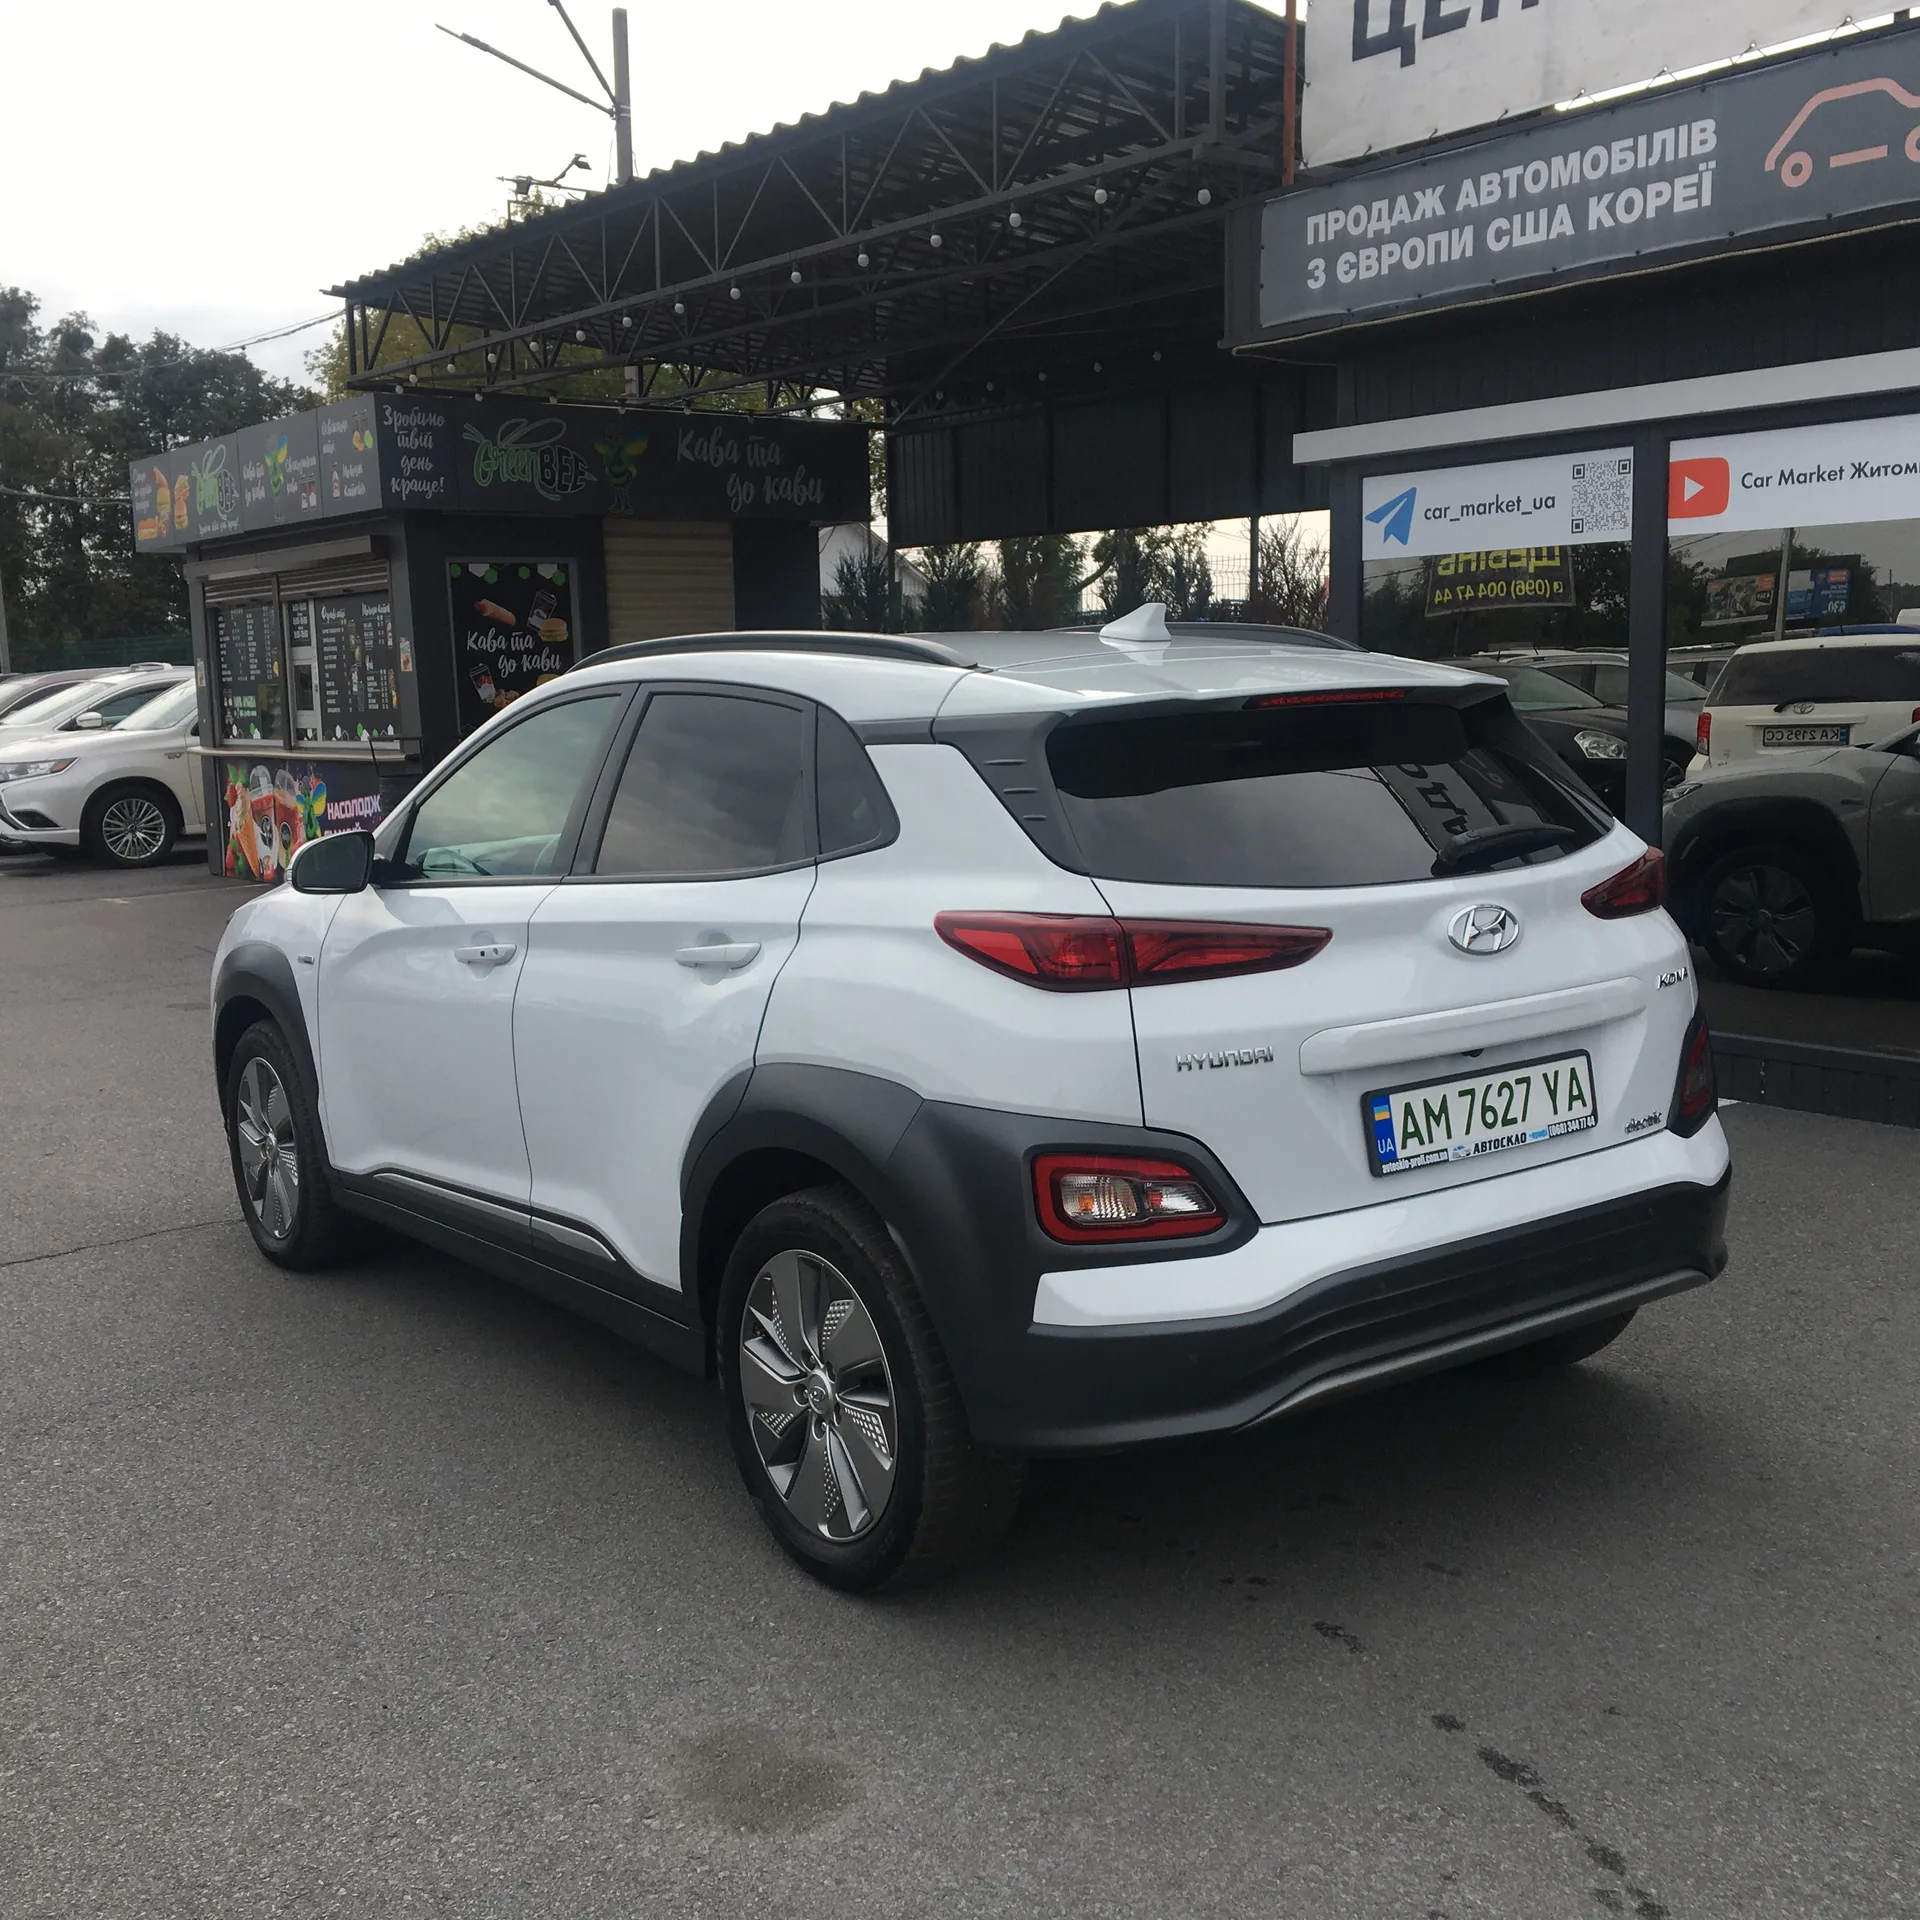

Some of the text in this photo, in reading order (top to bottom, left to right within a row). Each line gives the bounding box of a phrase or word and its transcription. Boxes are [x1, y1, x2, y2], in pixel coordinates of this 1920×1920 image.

[1306, 117, 1718, 246] ПРОДАЖ АВТОМОБІЛІВ
[1306, 160, 1718, 290] З ЄВРОПИ США КОРЕЇ
[382, 404, 446, 434] Зробимо
[396, 429, 435, 450] твій
[676, 424, 784, 468] Кава та
[400, 454, 434, 476] день
[1740, 460, 1920, 490] Car Market Житом
[389, 475, 445, 501] краще!
[726, 464, 825, 513] до кави
[1424, 493, 1556, 522] car_market_ua
[466, 627, 535, 653] Кава та
[497, 646, 562, 678] до кави
[1657, 966, 1688, 991] KONA
[1176, 1045, 1274, 1073] HYUNDAI
[1400, 1066, 1588, 1151] AM 7627 YA
[1624, 1110, 1663, 1135] electric
[1377, 1137, 1395, 1154] UA
